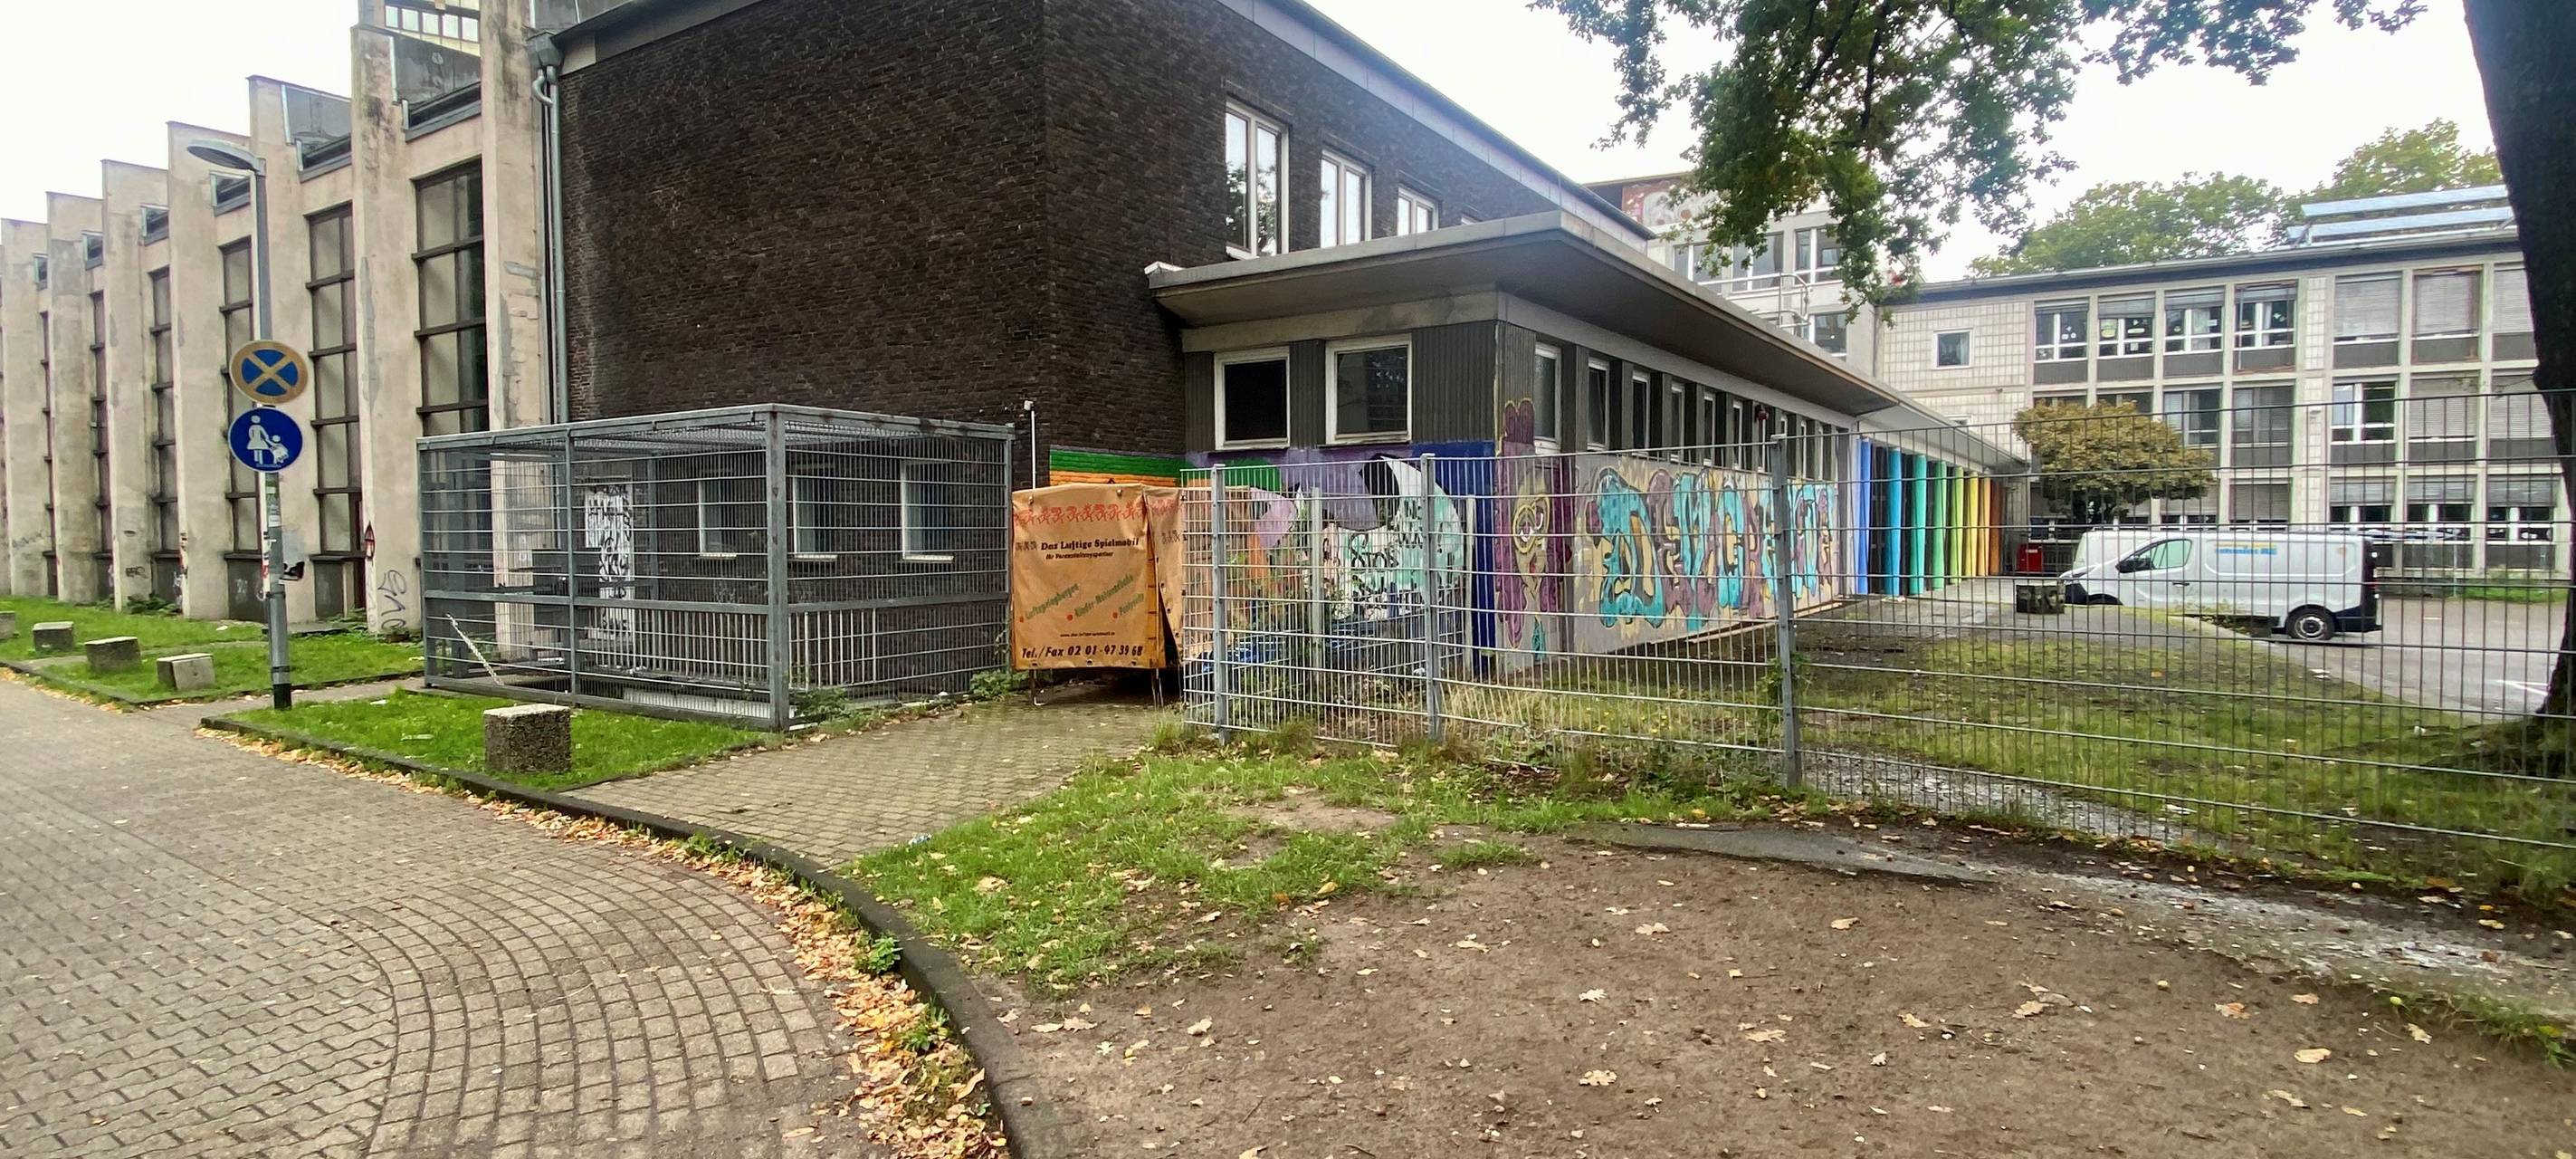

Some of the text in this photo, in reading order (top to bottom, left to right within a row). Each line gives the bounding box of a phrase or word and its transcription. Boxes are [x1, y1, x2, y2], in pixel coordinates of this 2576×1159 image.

[1041, 538, 1140, 551] Das Luftige Spielmobil
[1067, 645, 1082, 656] 02
[1118, 644, 1130, 656] 39
[1131, 645, 1144, 656] 68
